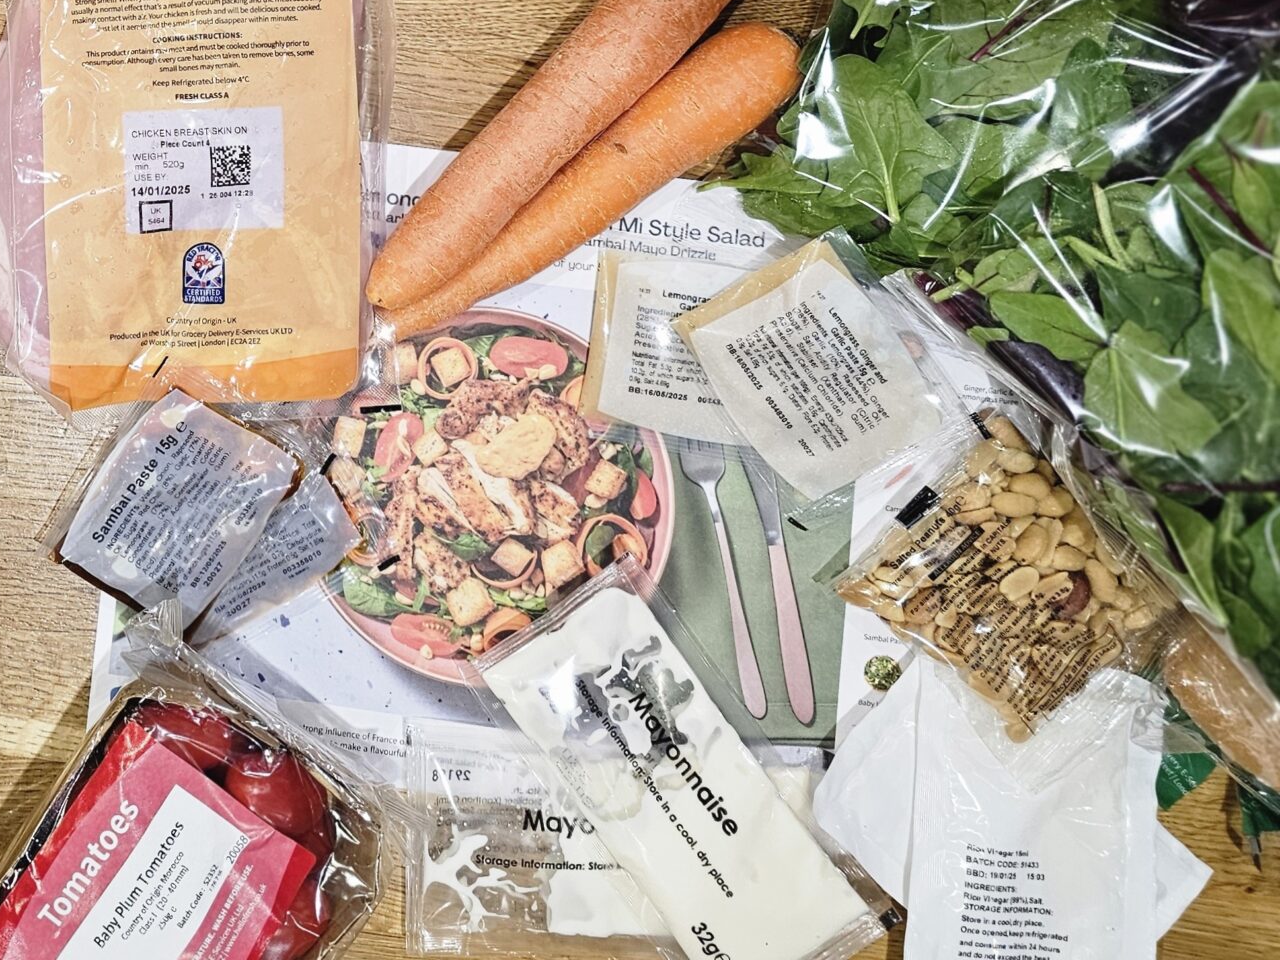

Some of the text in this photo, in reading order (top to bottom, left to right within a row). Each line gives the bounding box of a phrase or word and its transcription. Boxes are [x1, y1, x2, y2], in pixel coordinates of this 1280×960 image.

[175, 88, 199, 100] FRESH
[131, 127, 232, 138] CHICKEN BREAST SKIN
[133, 152, 168, 161] WEIGHT
[131, 185, 191, 197] 14/01/2025
[649, 219, 766, 248] Style Salad
[628, 240, 667, 256] Mayo
[670, 245, 717, 261] Drizzle
[568, 261, 595, 272] your
[208, 329, 234, 339] Delivery
[829, 307, 860, 351] Lemongrass,
[845, 345, 860, 365] Paste
[93, 434, 179, 544] Sambal Paste 15g
[890, 517, 947, 571] Salted Peanuts
[203, 561, 224, 588] 20027
[325, 727, 397, 744] influence France
[340, 742, 407, 758] make flavourful
[629, 691, 739, 837] Mayonnaise
[575, 679, 734, 899] Storage Information: Store dry place
[226, 835, 249, 866] 20058
[966, 855, 995, 867] BATCH
[37, 798, 140, 929] Tomatoes
[475, 854, 586, 871] Storage Information:
[94, 916, 122, 949] Baby
[114, 885, 144, 920] Plum
[137, 820, 185, 886] Tomatoes
[121, 913, 141, 941] Country
[160, 851, 185, 886] Morocco
[963, 903, 1054, 916] STORAGE INFORMATION:
[691, 923, 723, 957] 32g
